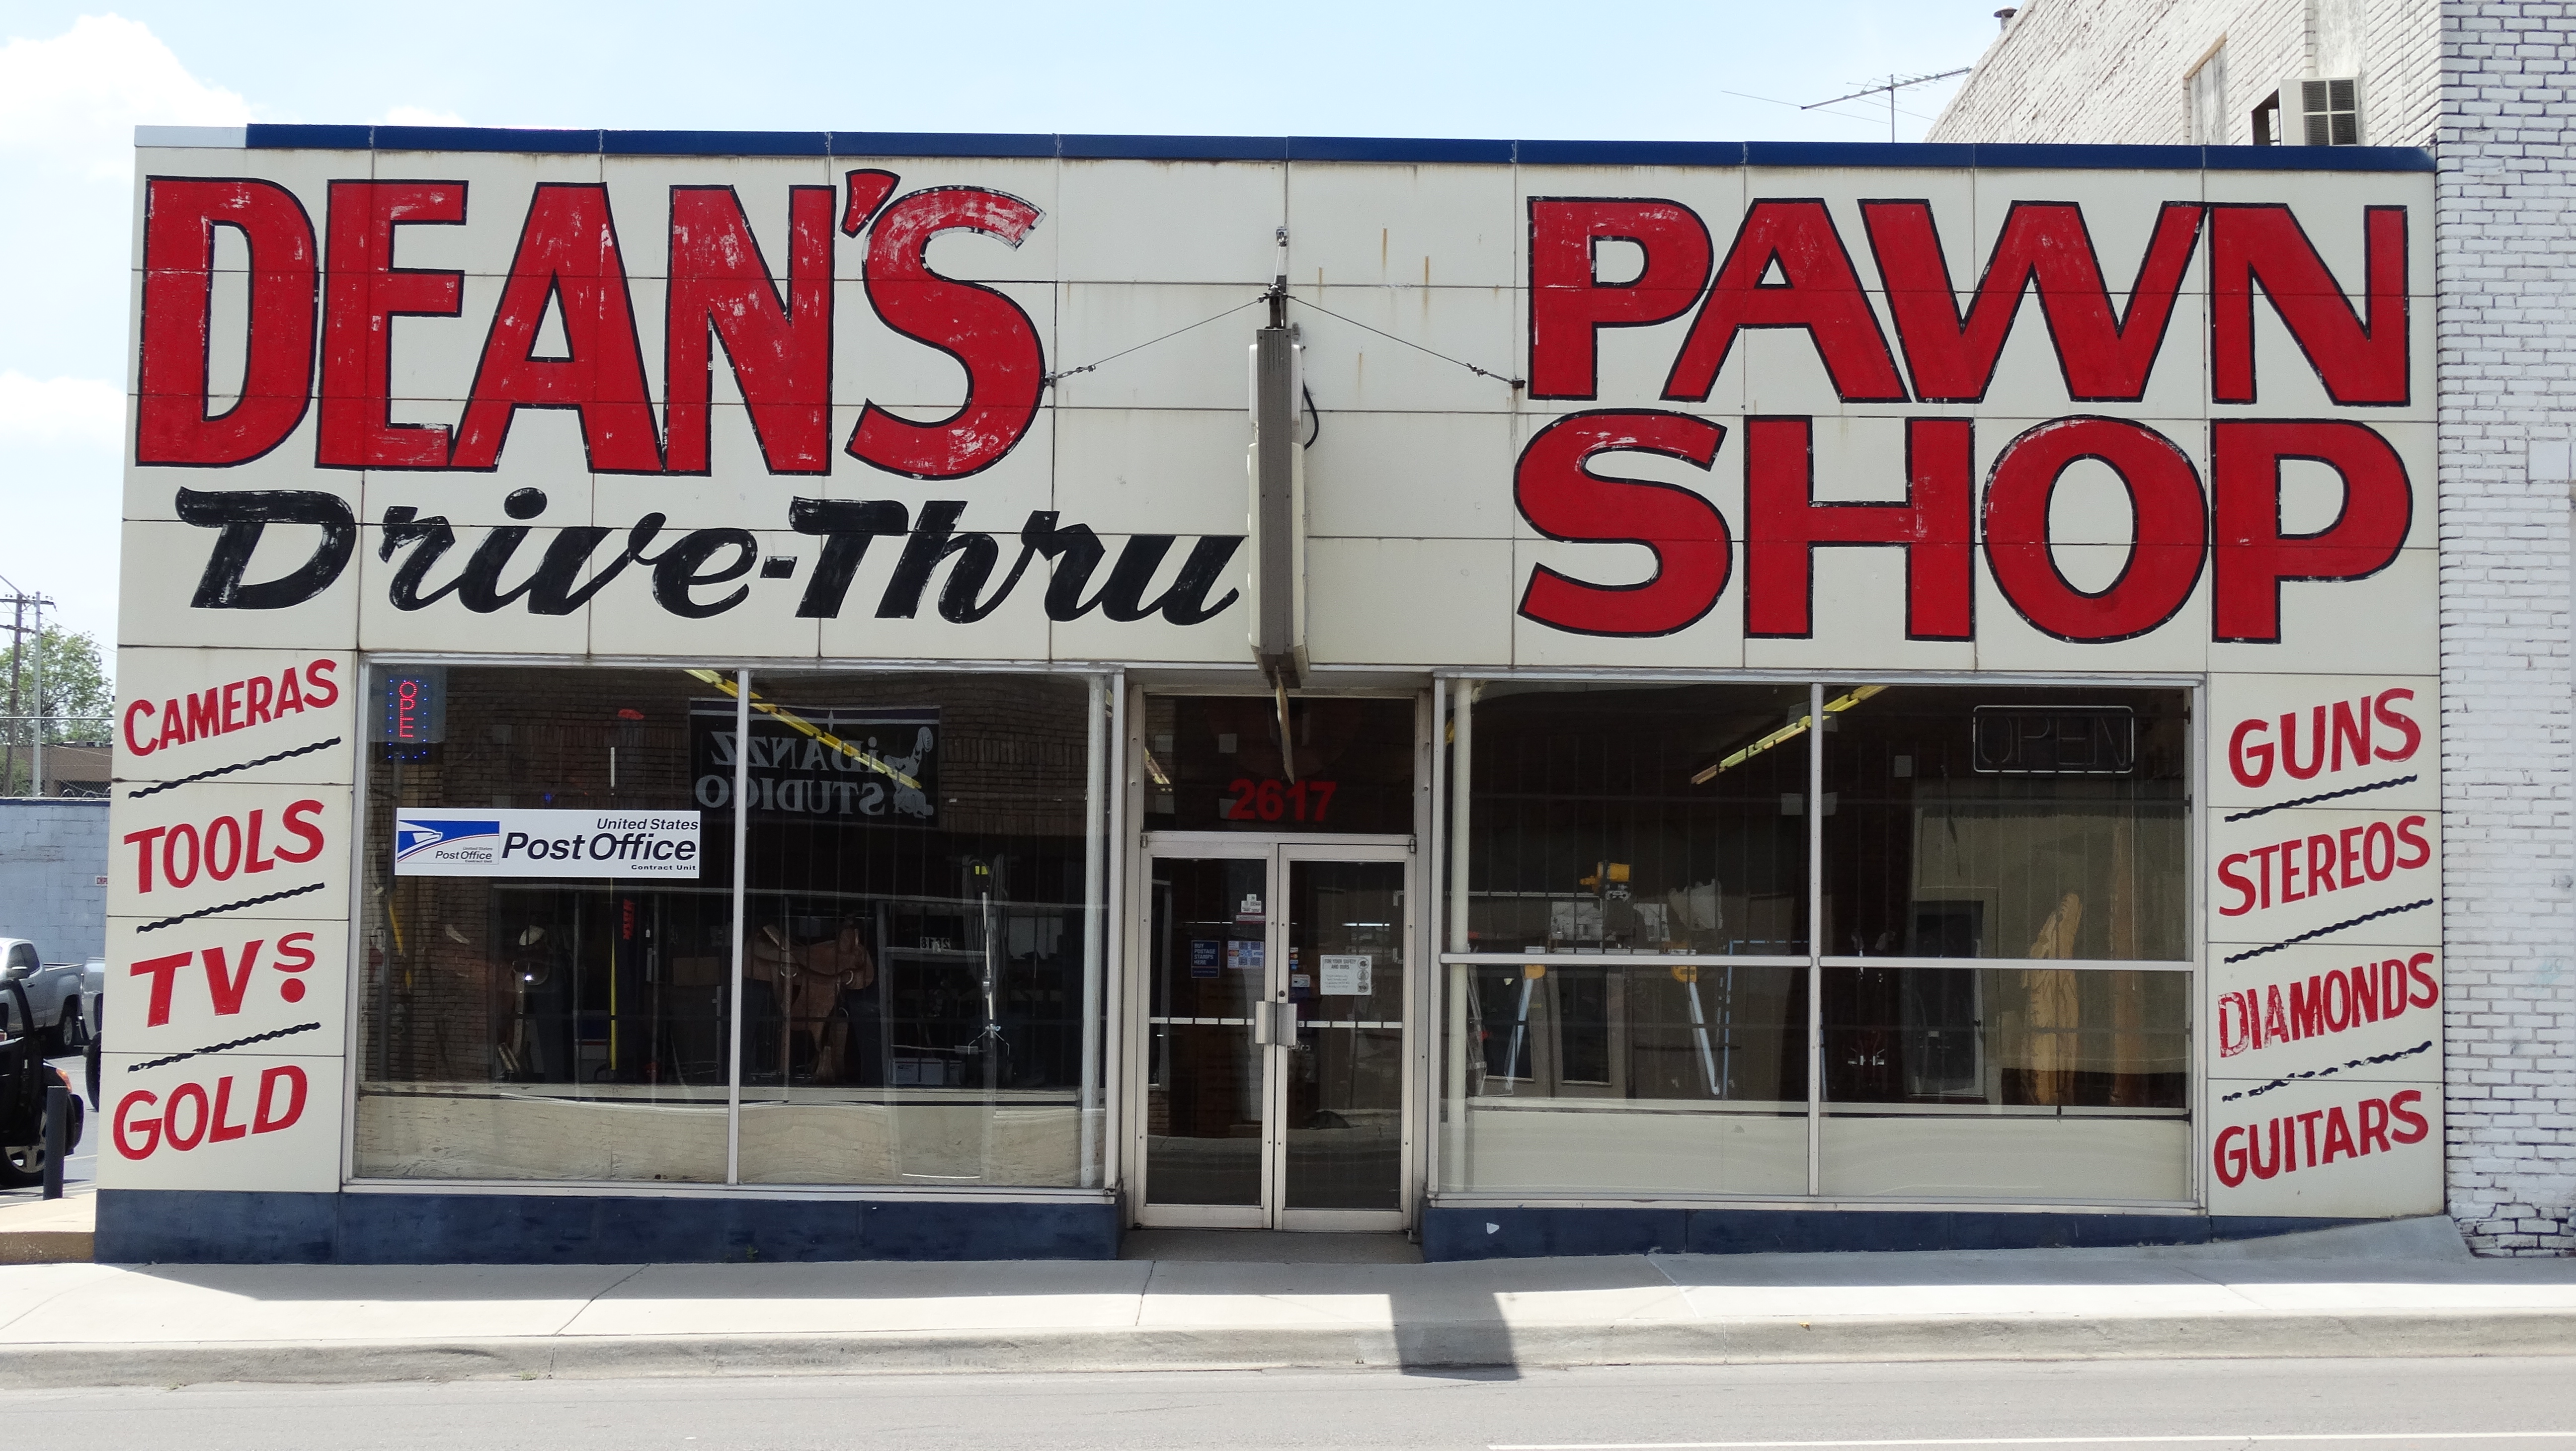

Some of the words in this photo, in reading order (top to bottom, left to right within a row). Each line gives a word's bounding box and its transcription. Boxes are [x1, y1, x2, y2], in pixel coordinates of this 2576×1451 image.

[135, 170, 1046, 480] DEAN'S
[1527, 197, 2411, 406] PAWN
[176, 487, 1243, 625] Drive-Thru
[1514, 408, 2413, 643] SHOP
[124, 659, 338, 756] CAMERAS
[1980, 716, 2127, 767] OPEN
[2229, 688, 2421, 788] GUNS
[124, 799, 324, 893] TOOLS
[501, 832, 585, 860] Post
[589, 832, 697, 861] Office
[597, 818, 647, 830] United
[650, 818, 699, 830] States
[1228, 779, 1337, 821] 2617
[435, 851, 459, 859] Post
[461, 851, 492, 860] Office
[2218, 815, 2431, 916] STEREOS
[2219, 952, 2439, 1057] DIAMONDS
[112, 1065, 308, 1160] GOLD
[2214, 1090, 2428, 1187] GUITARS
